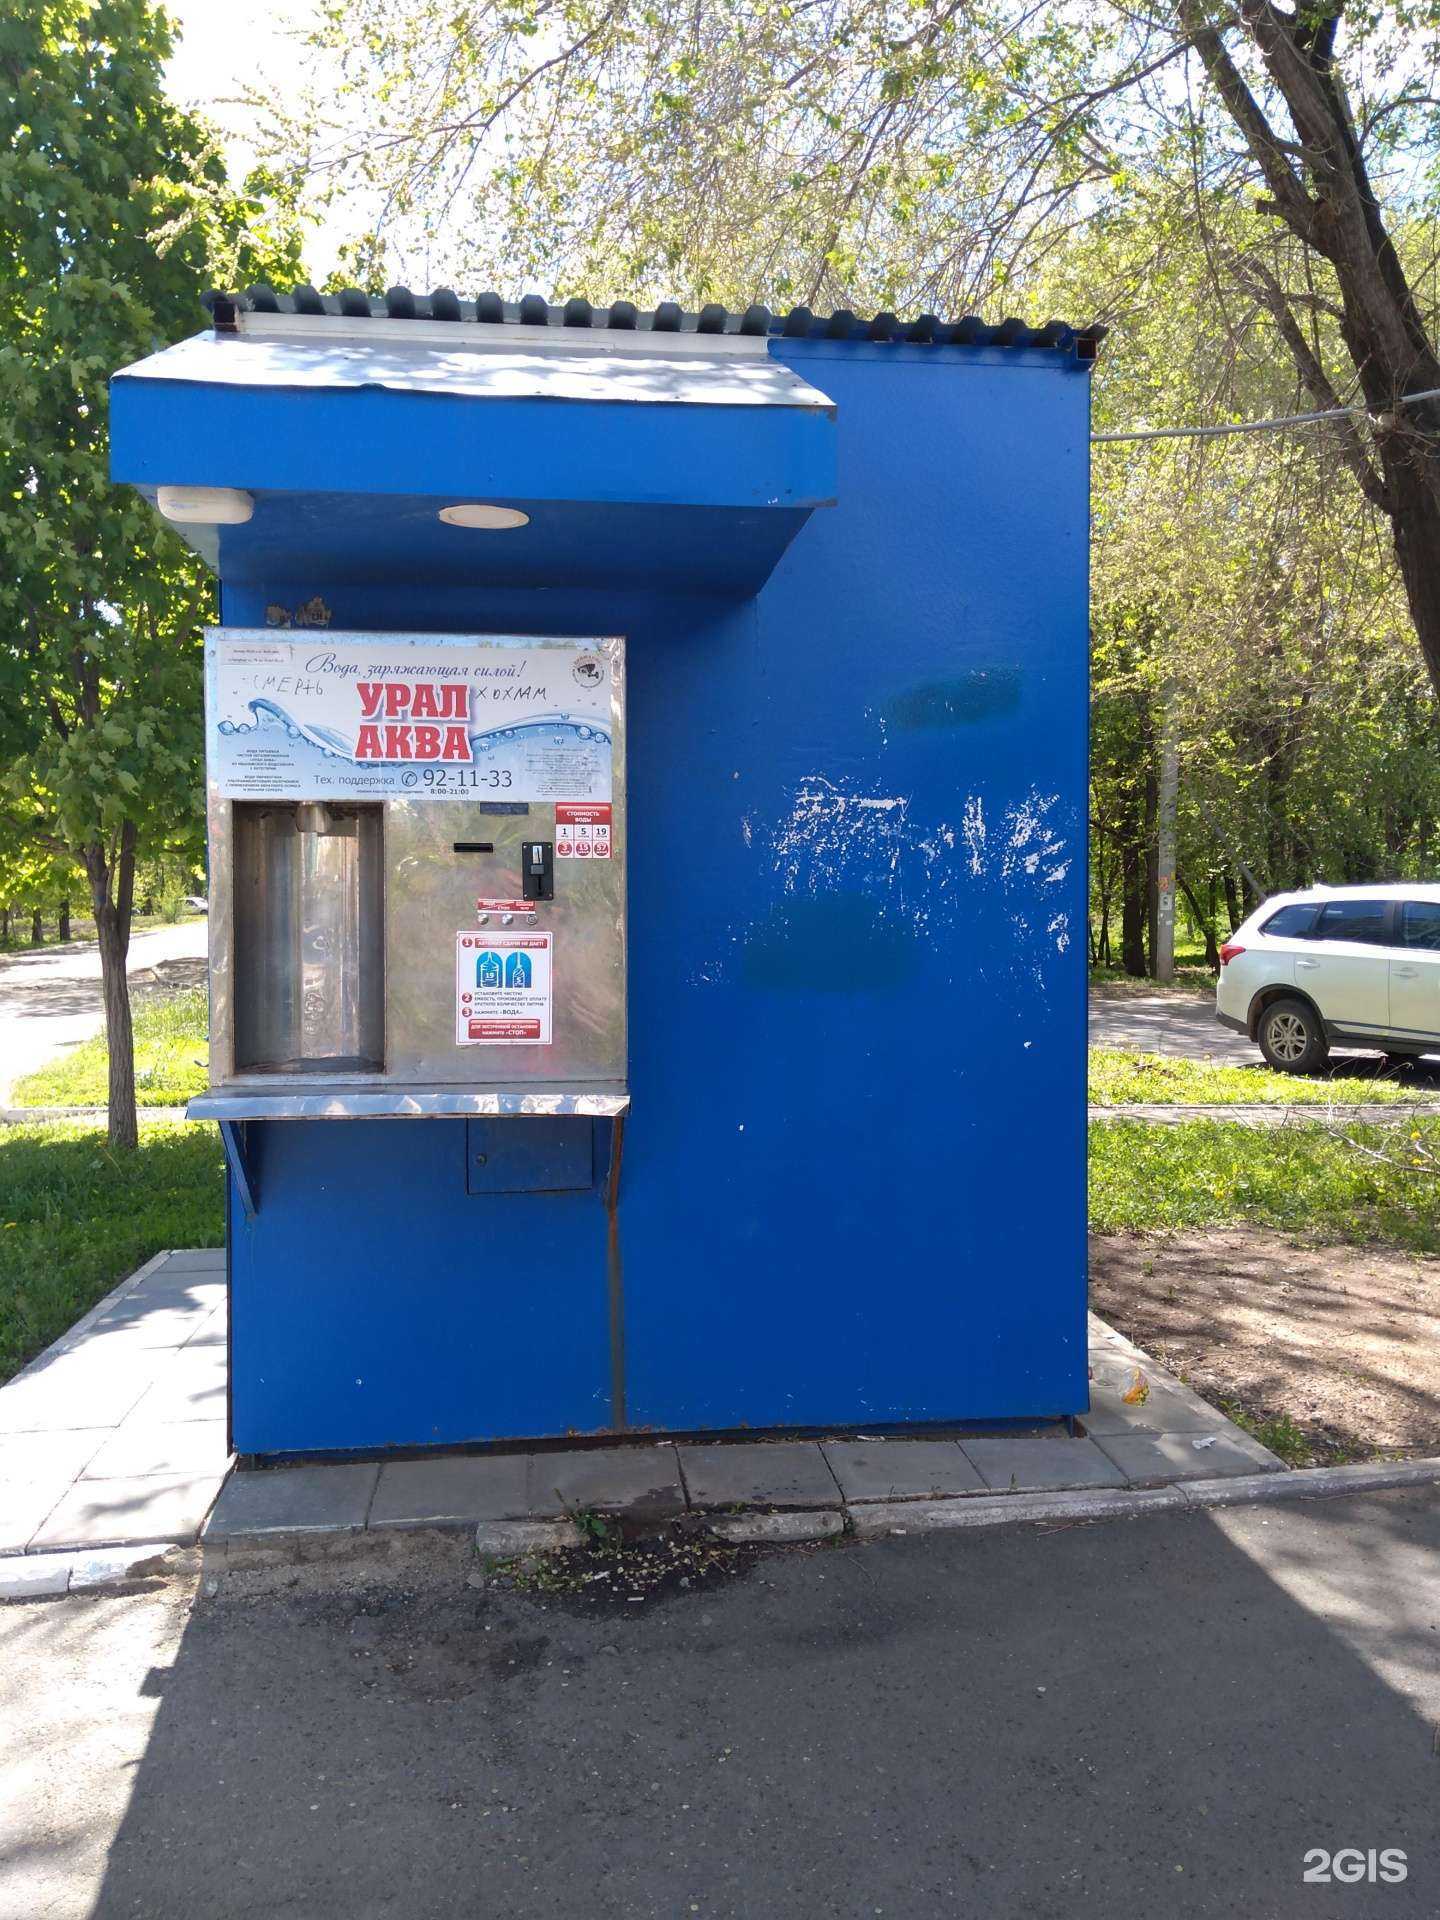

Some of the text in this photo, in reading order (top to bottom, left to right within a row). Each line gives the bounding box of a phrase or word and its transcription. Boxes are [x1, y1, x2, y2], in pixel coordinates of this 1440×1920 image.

[305, 652, 528, 680] Вода, заряжающая силой!
[356, 682, 468, 718] УРАЛ
[355, 725, 470, 760] АКВА
[314, 774, 334, 785] Тех.
[338, 776, 395, 787] поддержка
[423, 769, 513, 788] 92-11-33
[562, 827, 567, 835] 1
[581, 827, 587, 835] 5
[596, 827, 607, 835] 19
